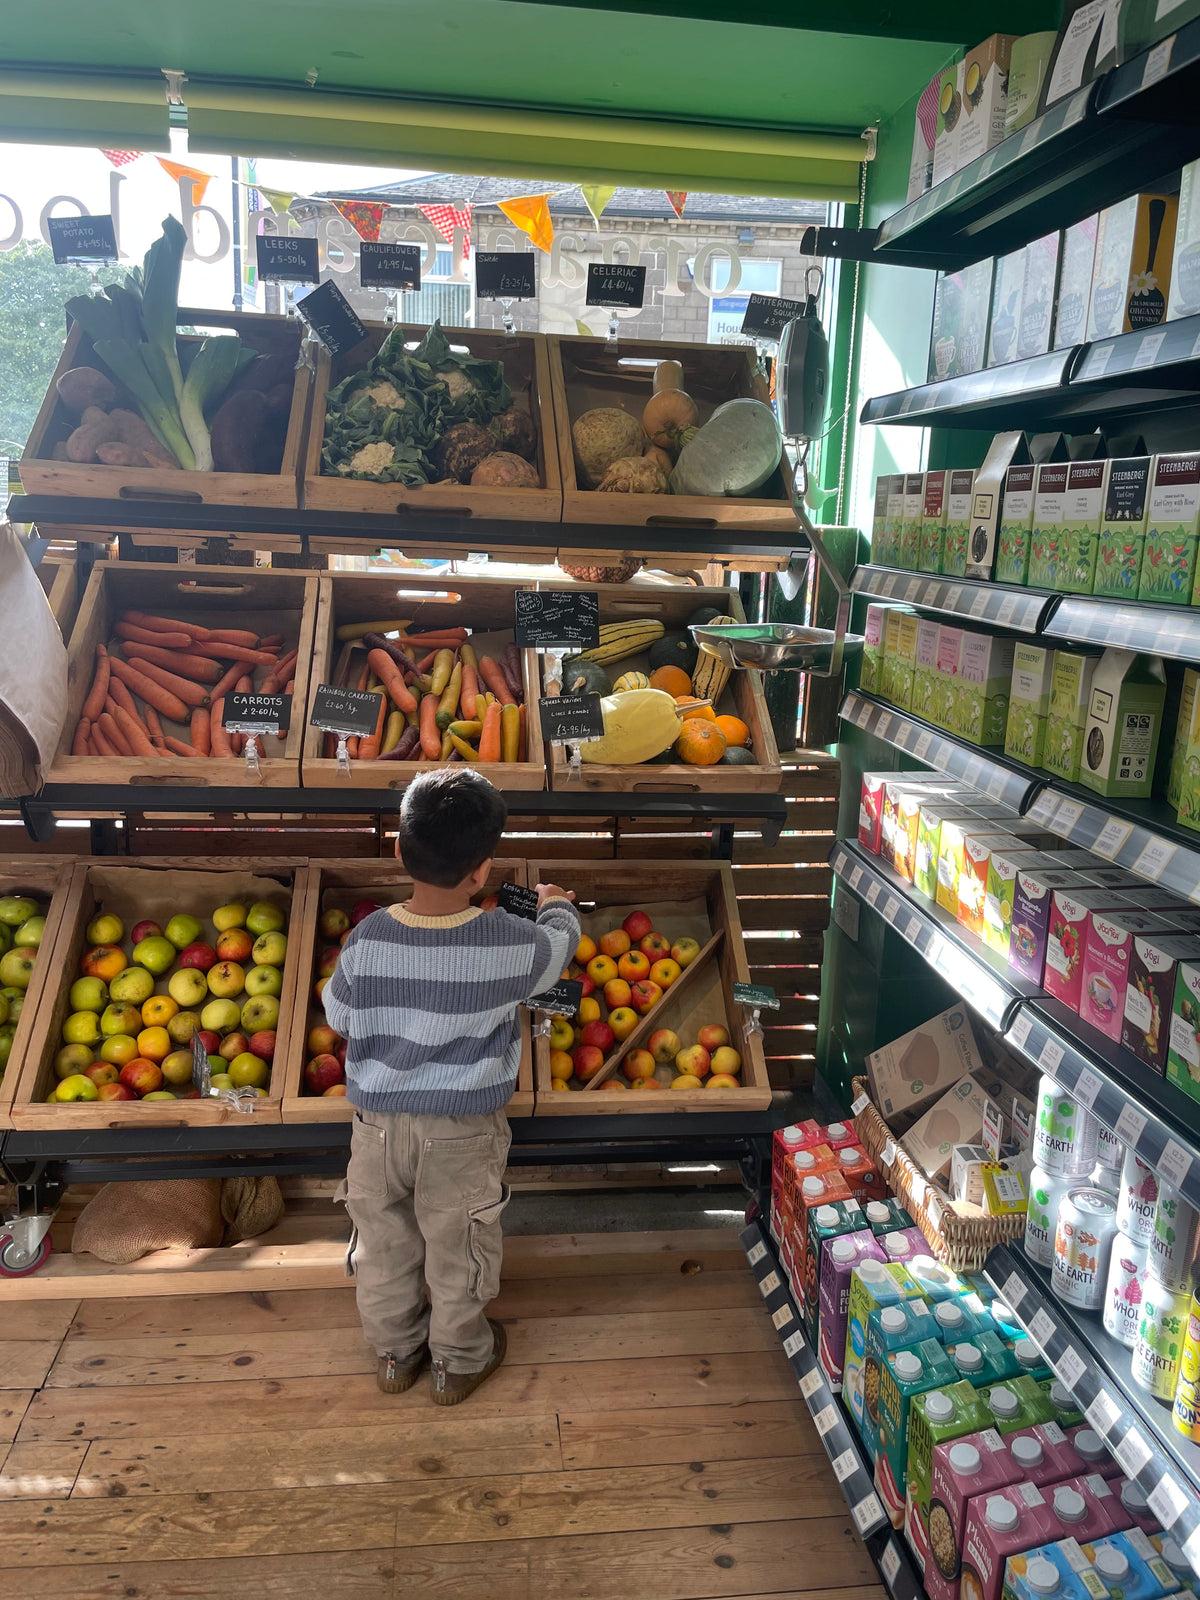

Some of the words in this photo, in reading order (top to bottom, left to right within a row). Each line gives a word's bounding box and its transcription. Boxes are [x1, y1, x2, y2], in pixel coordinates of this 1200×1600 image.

[63, 228, 94, 237] POTATO
[264, 239, 298, 250] LEEKS
[362, 244, 418, 256] CAULIFLOWER
[592, 266, 638, 278] CELERIAC
[751, 295, 799, 310] BUTTERNUT
[1159, 460, 1198, 473] STEENBERGS
[1111, 470, 1146, 482] STEENBERGS
[233, 695, 283, 706] CARROTS
[318, 685, 347, 697] RAINBOW
[347, 691, 377, 703] CARROTS
[997, 861, 1010, 875] Yogi
[1062, 900, 1077, 916] Yogi
[1143, 947, 1160, 965] Yogi
[1046, 1135, 1074, 1154] EARTH
[1127, 1196, 1155, 1219] WHOL
[1066, 1262, 1097, 1285] EARTH
[1112, 1296, 1139, 1321] WHOL
[1144, 1351, 1177, 1374] EARTH
